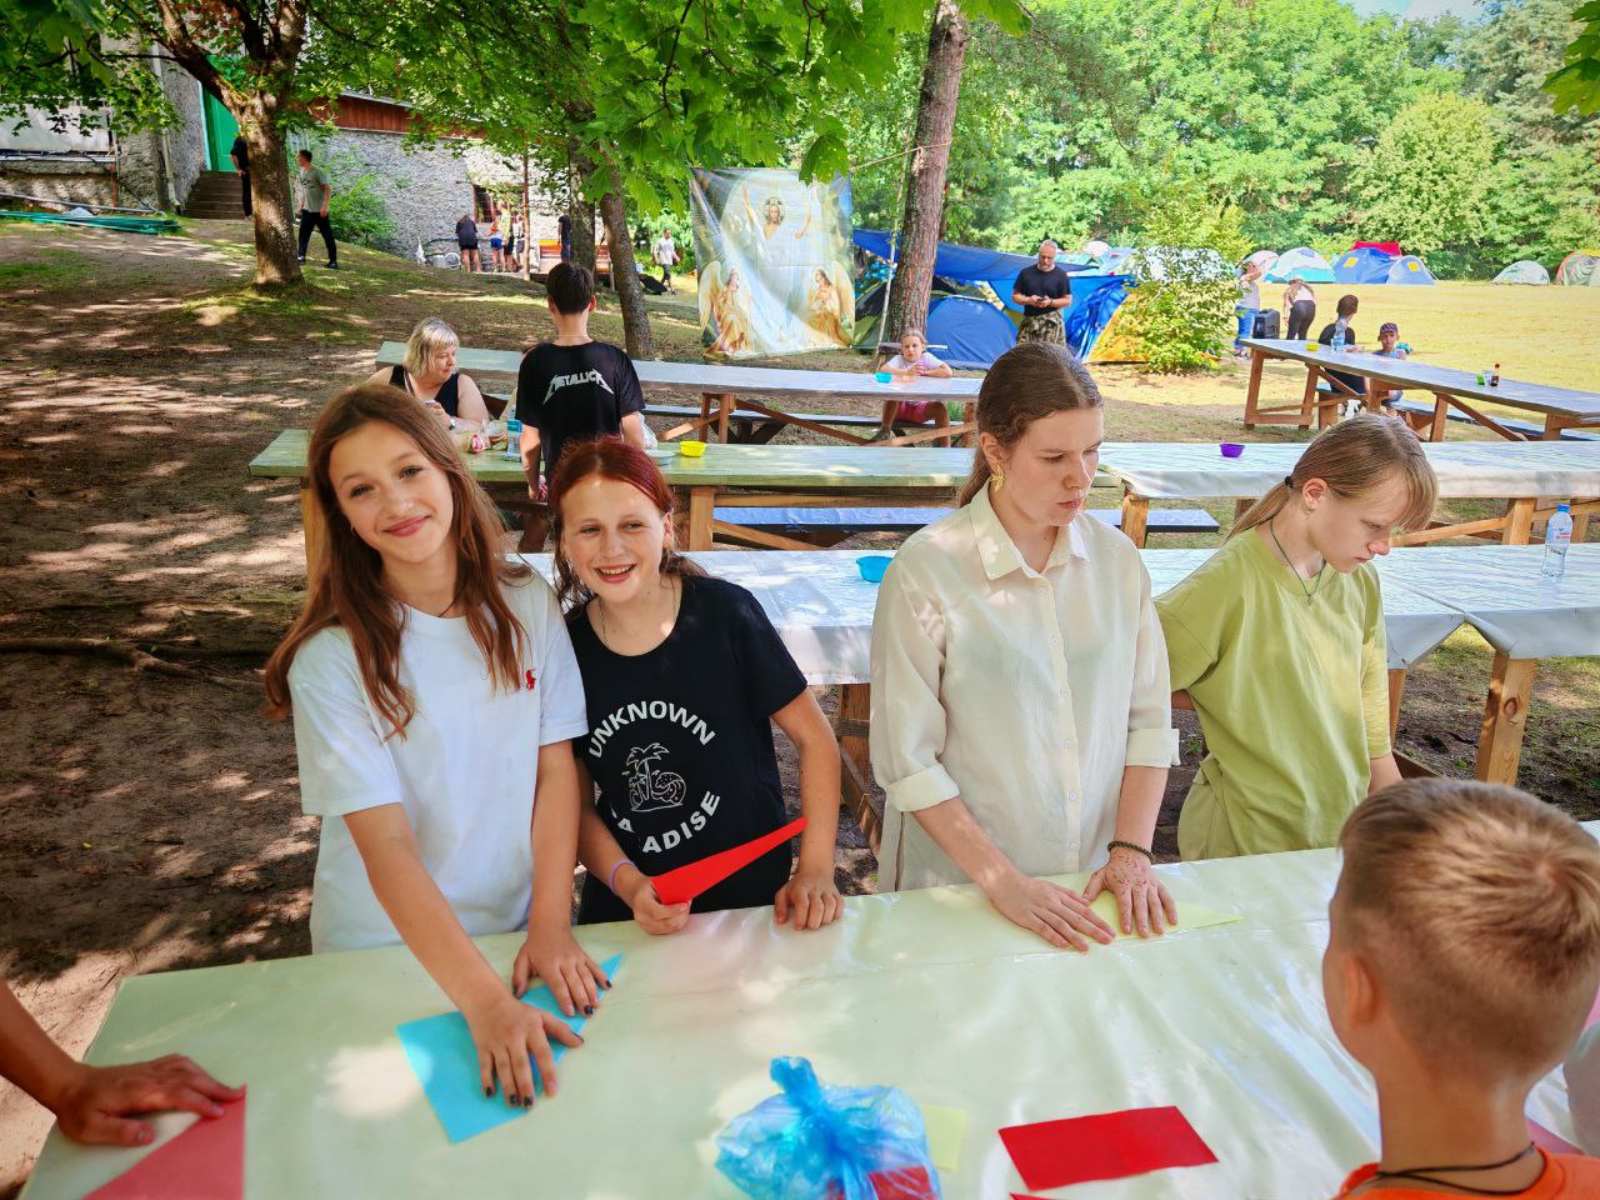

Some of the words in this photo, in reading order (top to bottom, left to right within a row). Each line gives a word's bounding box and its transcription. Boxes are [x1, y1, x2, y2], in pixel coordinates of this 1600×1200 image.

[542, 368, 615, 405] METALLICA
[589, 700, 716, 758] UNKNOWN
[610, 791, 721, 853] AADISE
